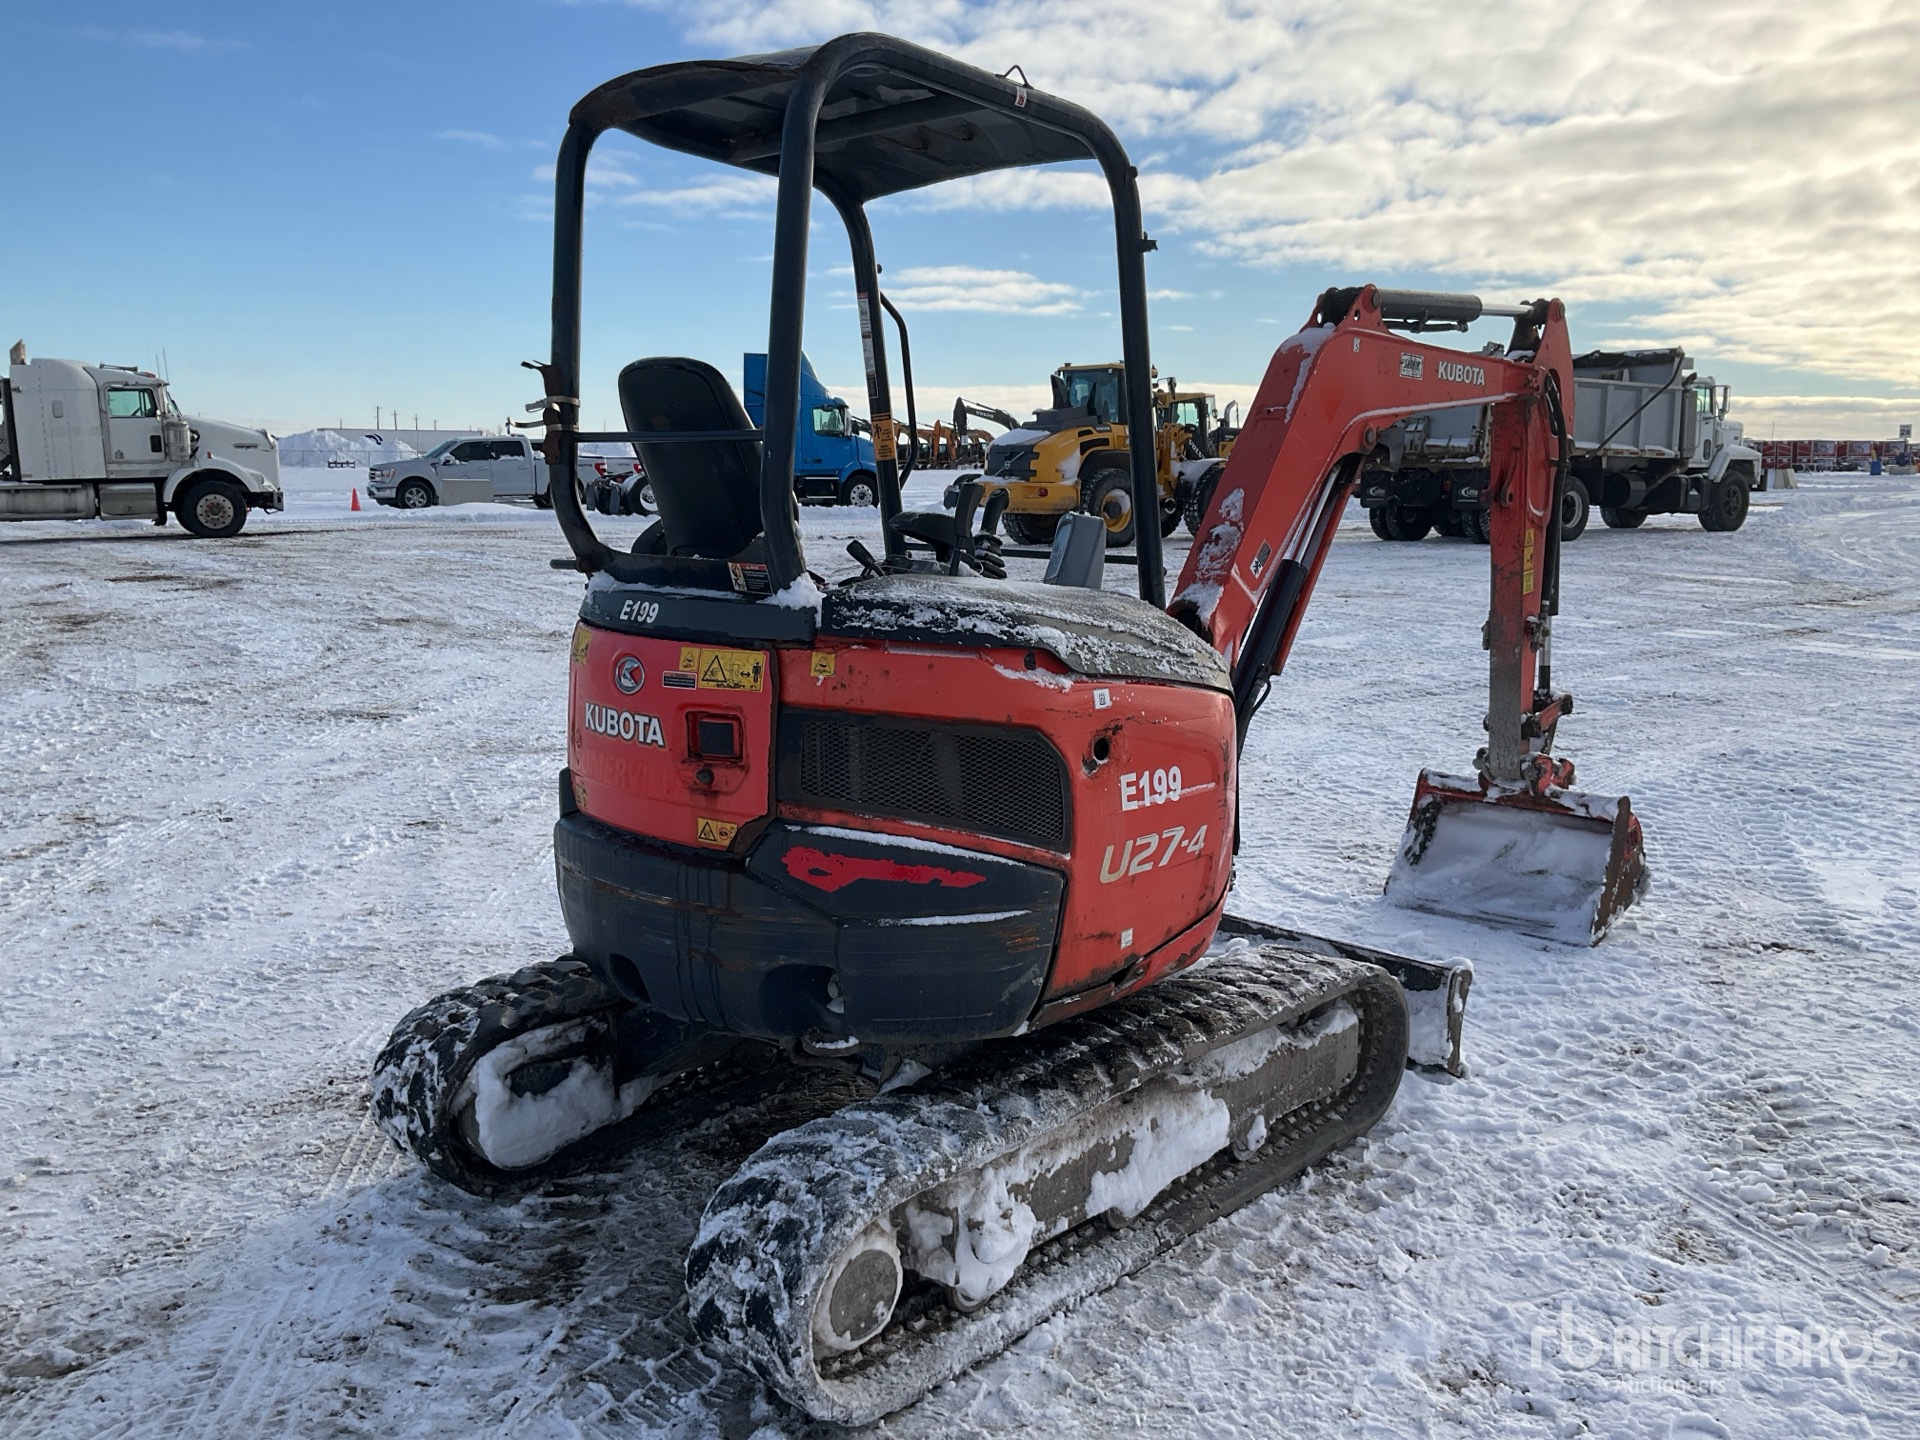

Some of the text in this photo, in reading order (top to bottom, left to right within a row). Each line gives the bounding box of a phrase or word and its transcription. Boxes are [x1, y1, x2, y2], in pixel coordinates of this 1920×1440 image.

[1438, 361, 1485, 386] KUBOTA
[619, 599, 659, 624] E199
[585, 702, 664, 747] KUBOTA
[1120, 766, 1182, 811] E199
[1100, 824, 1208, 884] U27-4
